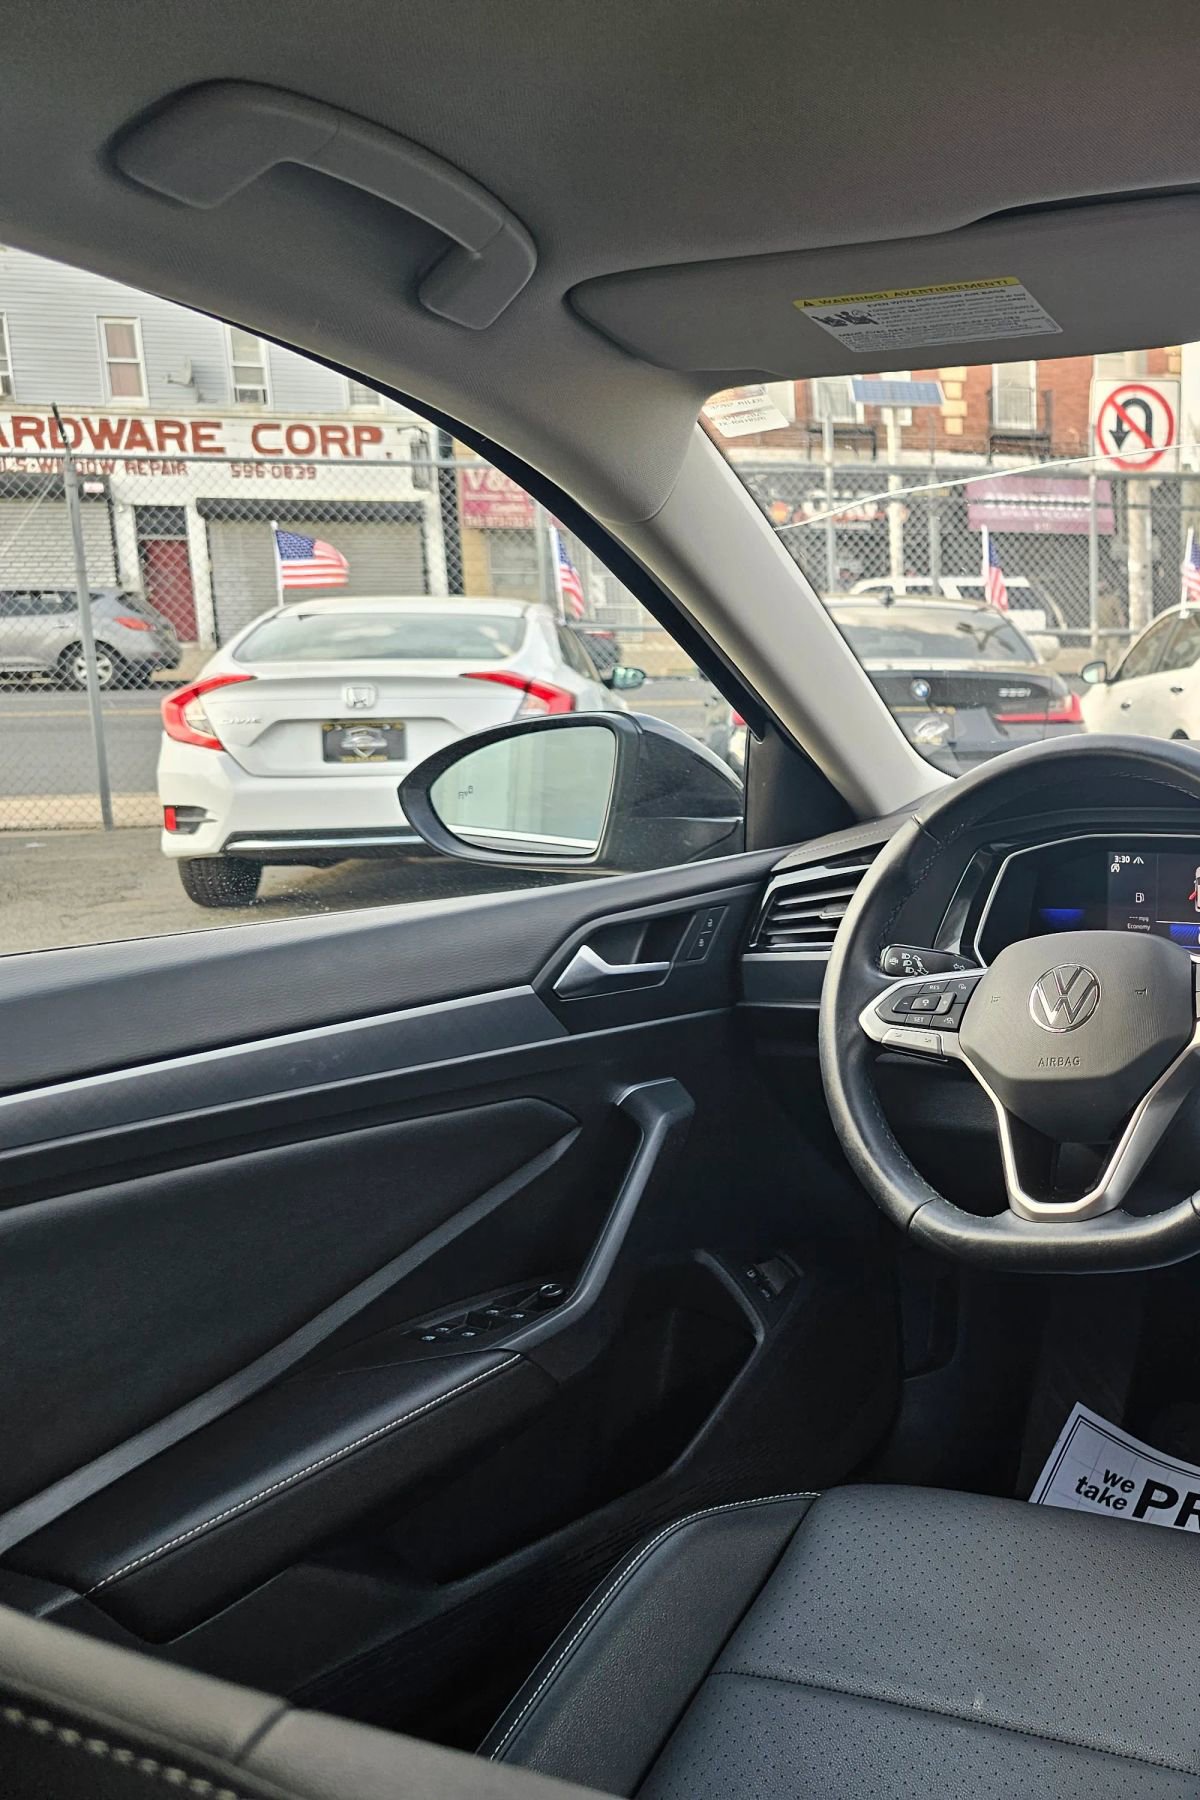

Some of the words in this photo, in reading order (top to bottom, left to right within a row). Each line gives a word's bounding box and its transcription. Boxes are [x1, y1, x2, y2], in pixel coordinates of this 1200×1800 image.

[818, 292, 889, 306] WARNING!
[894, 279, 1009, 297] AVERTISSEMENT!
[251, 423, 393, 459] CORP.
[124, 459, 189, 476] REPAIR
[1114, 855, 1131, 864] 3:30
[1127, 923, 1151, 932] Economy
[1038, 1056, 1081, 1068] AIRBAG
[1103, 1469, 1135, 1494] we
[1074, 1476, 1128, 1511] take
